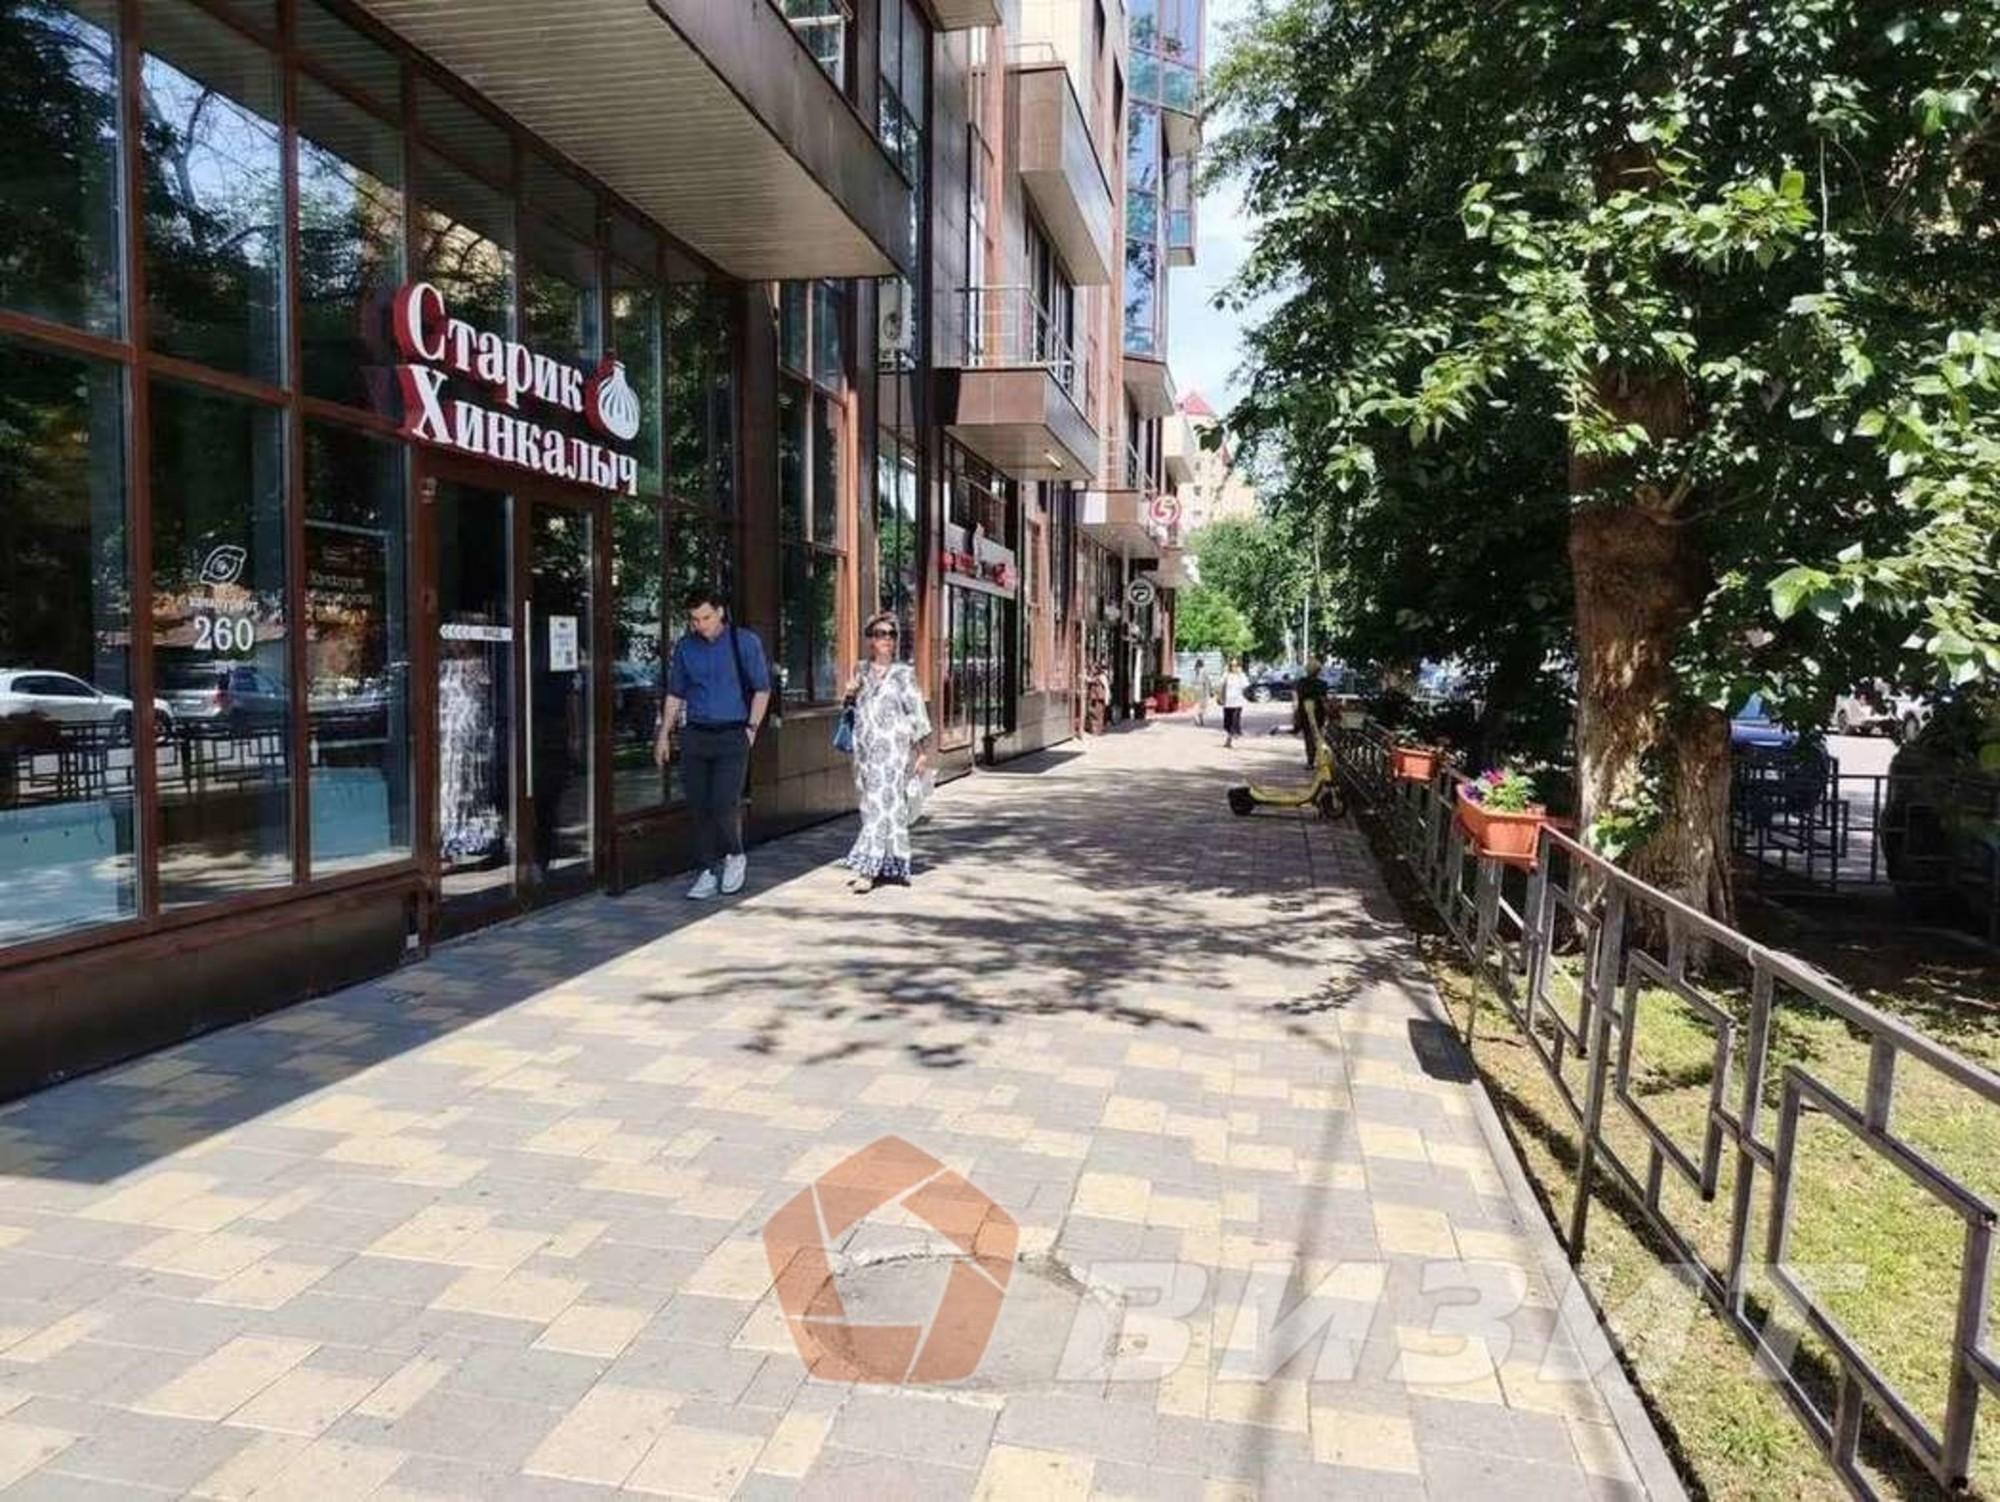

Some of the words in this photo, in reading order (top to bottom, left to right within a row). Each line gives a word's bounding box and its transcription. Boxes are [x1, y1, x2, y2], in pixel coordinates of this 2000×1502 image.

[402, 282, 584, 412] Старик
[409, 364, 638, 496] Хинкалыч
[193, 615, 255, 651] 260
